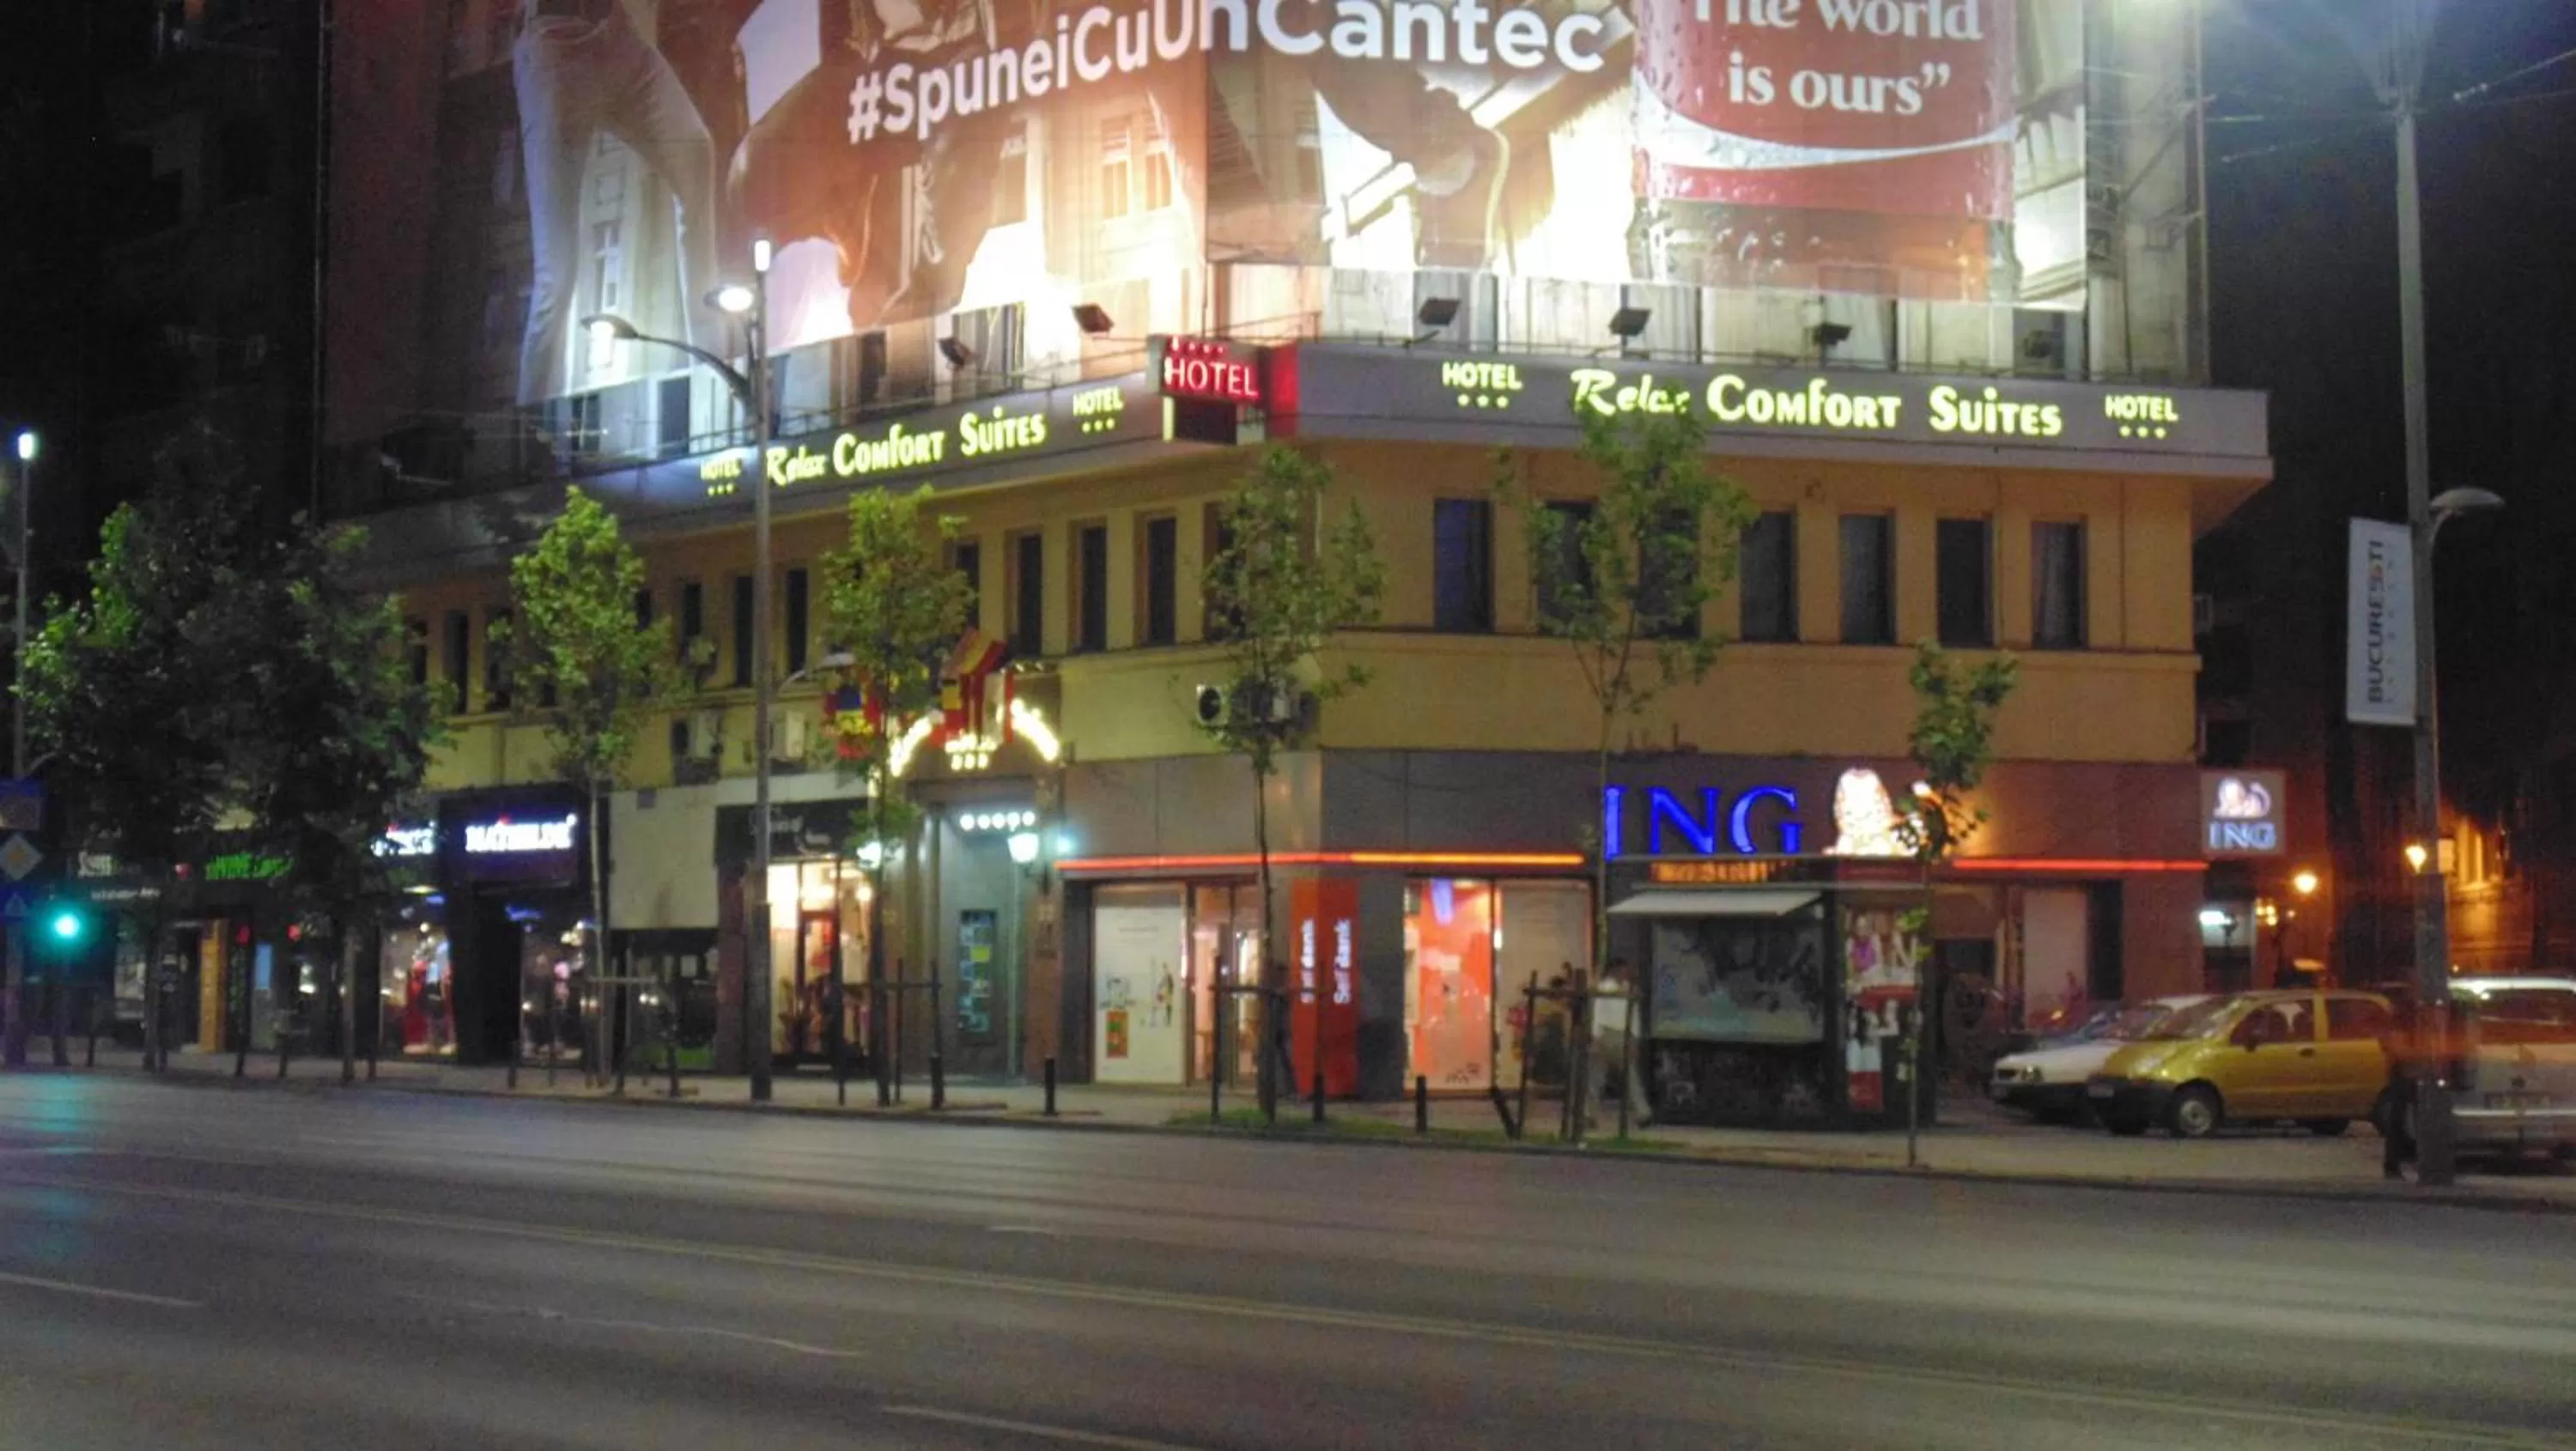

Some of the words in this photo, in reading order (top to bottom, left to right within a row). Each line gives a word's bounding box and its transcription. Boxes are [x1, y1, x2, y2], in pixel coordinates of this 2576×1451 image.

[1728, 51, 1776, 106] is
[1163, 356, 1260, 398] HOTEL
[1442, 361, 1522, 390] HOTEL
[1072, 386, 1124, 416] HOTEL
[2105, 394, 2178, 422] HOTEL
[1603, 783, 1805, 861] ING
[2208, 821, 2275, 851] ING
